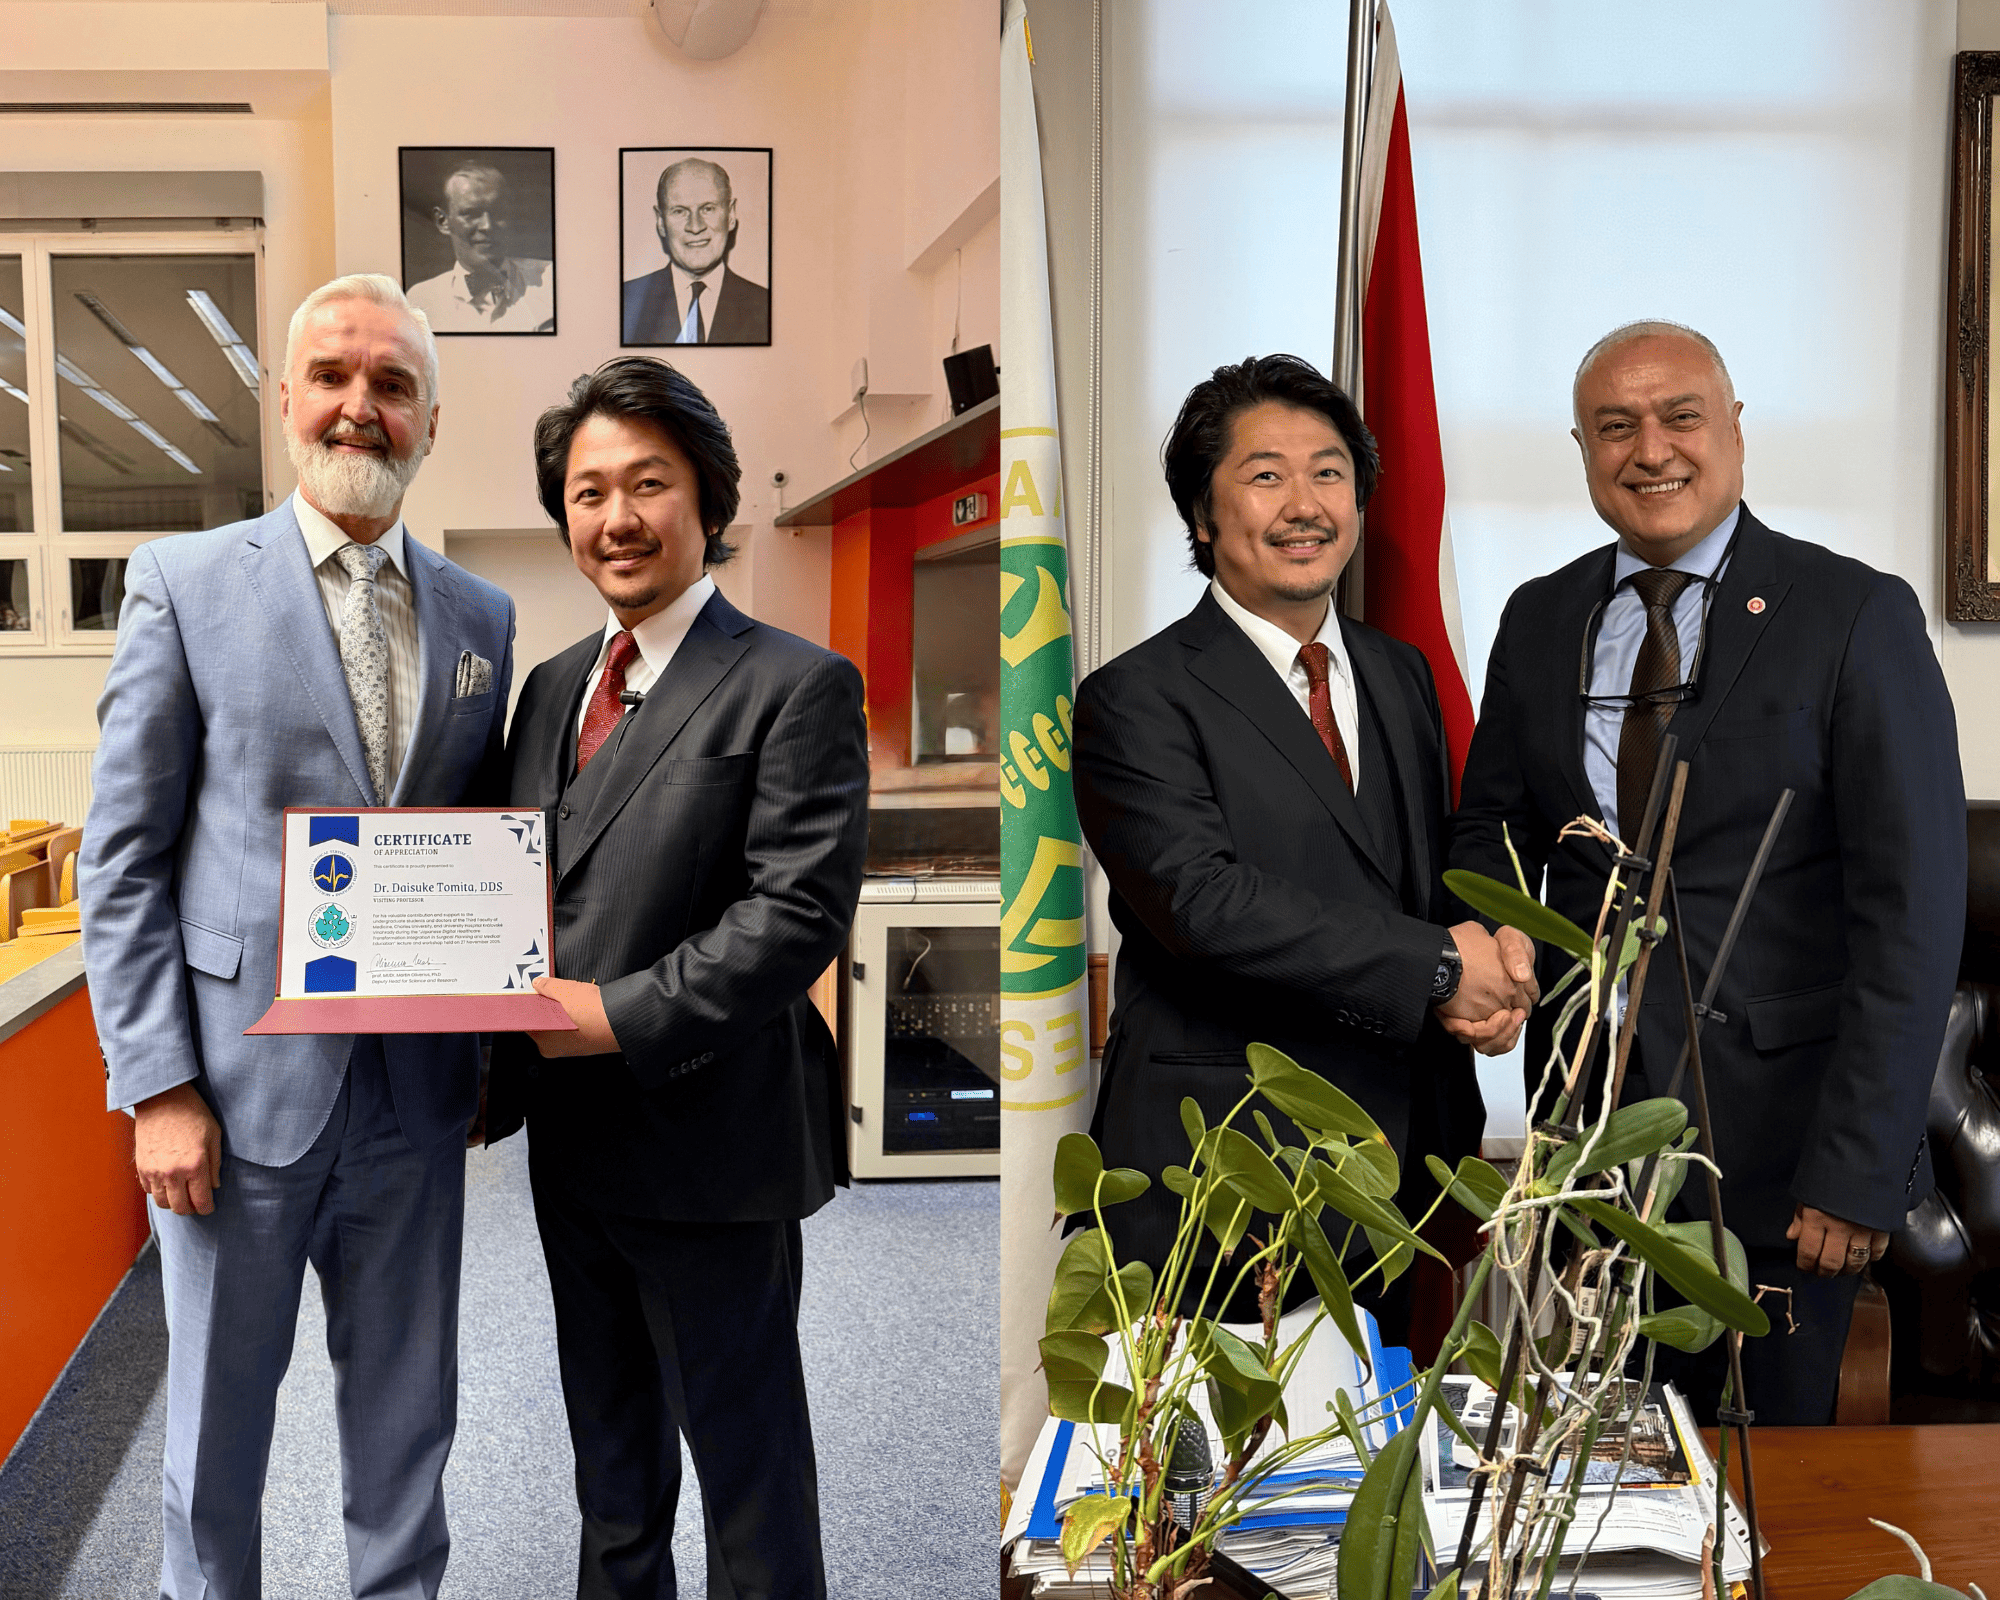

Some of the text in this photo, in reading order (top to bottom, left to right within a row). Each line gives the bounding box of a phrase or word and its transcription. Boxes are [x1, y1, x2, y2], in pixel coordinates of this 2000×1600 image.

[1001, 460, 1062, 518] A
[374, 834, 471, 845] CERTIFICATE
[374, 882, 503, 893] Dr. Daisuke Tomita, DDS
